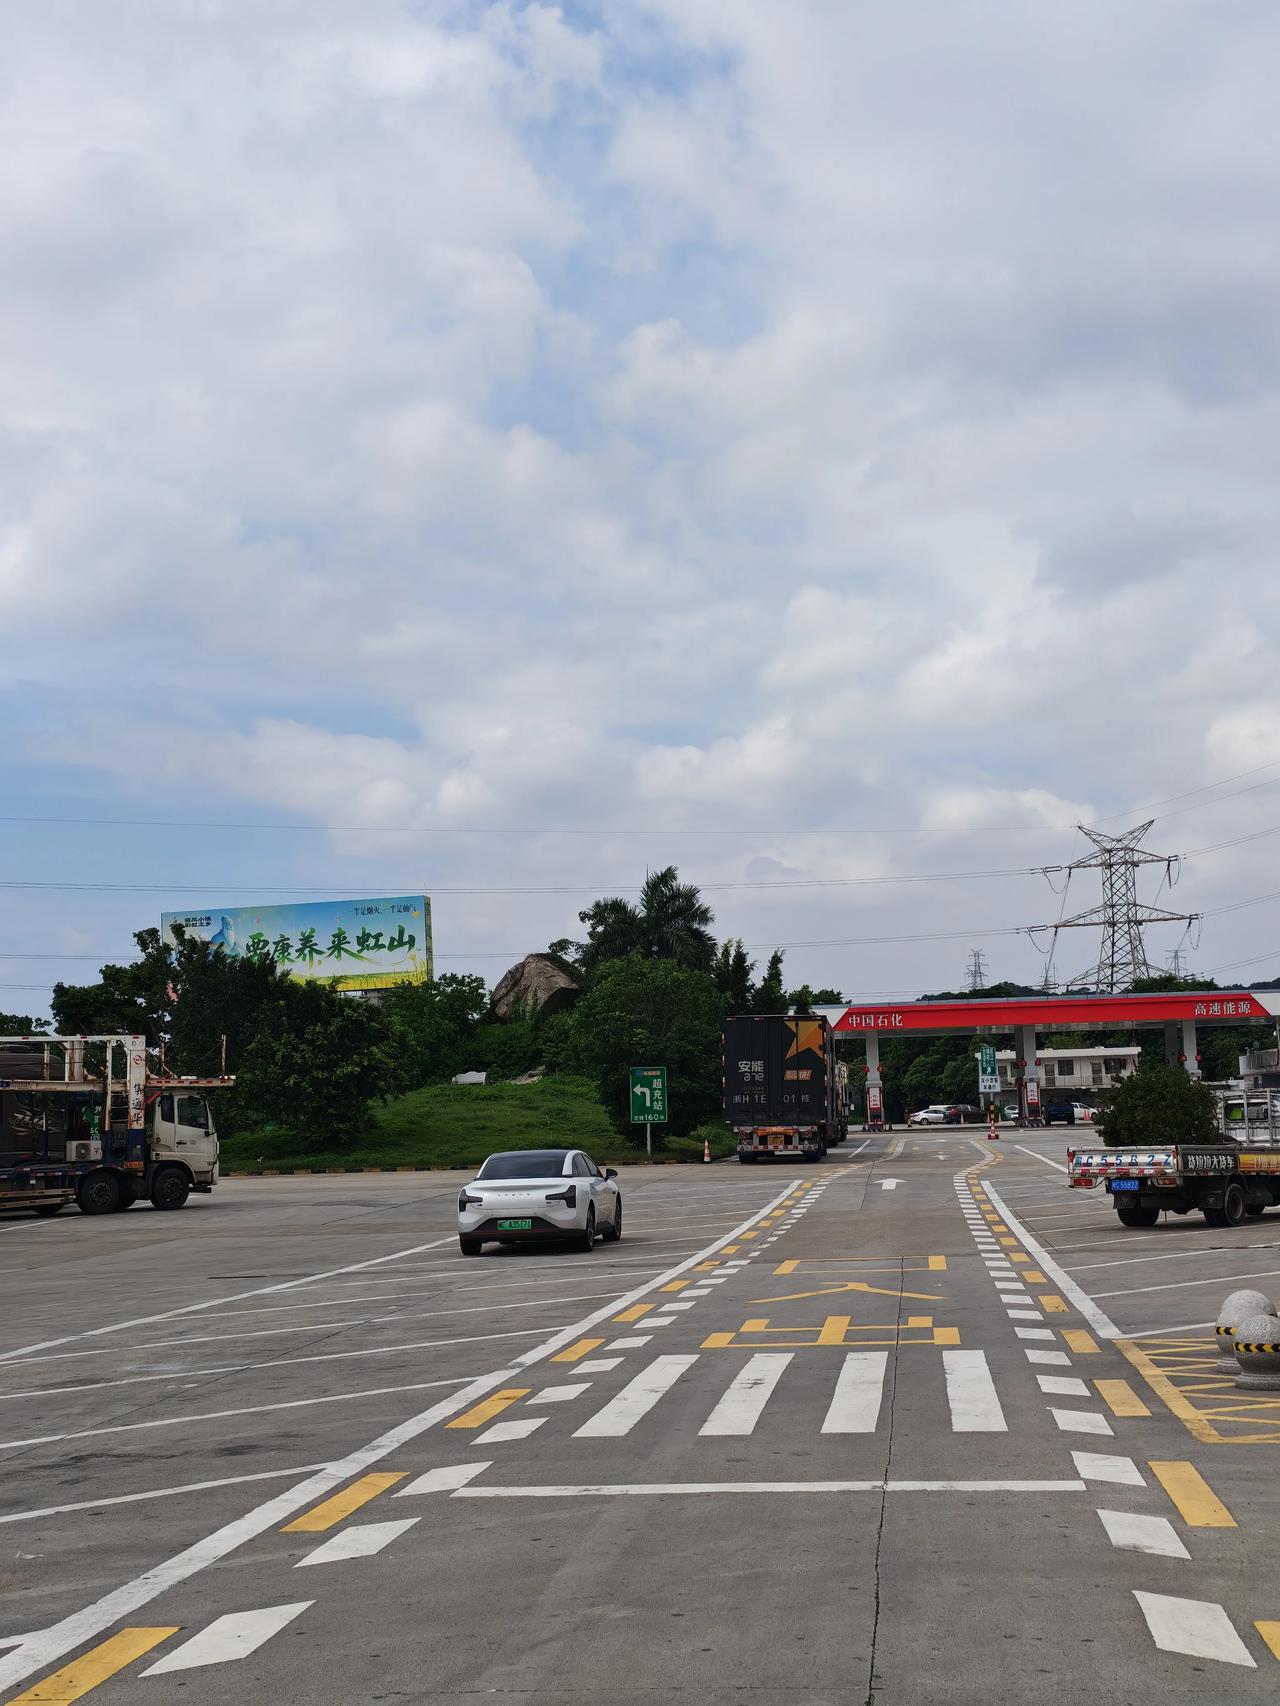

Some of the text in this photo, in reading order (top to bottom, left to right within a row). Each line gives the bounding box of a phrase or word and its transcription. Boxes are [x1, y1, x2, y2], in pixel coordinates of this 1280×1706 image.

[1194, 1001, 1251, 1015] 高速能源
[849, 1013, 903, 1027] 中国石化
[738, 1060, 764, 1073] 安能
[743, 1072, 764, 1082] ane
[652, 1078, 663, 1111] 超充站
